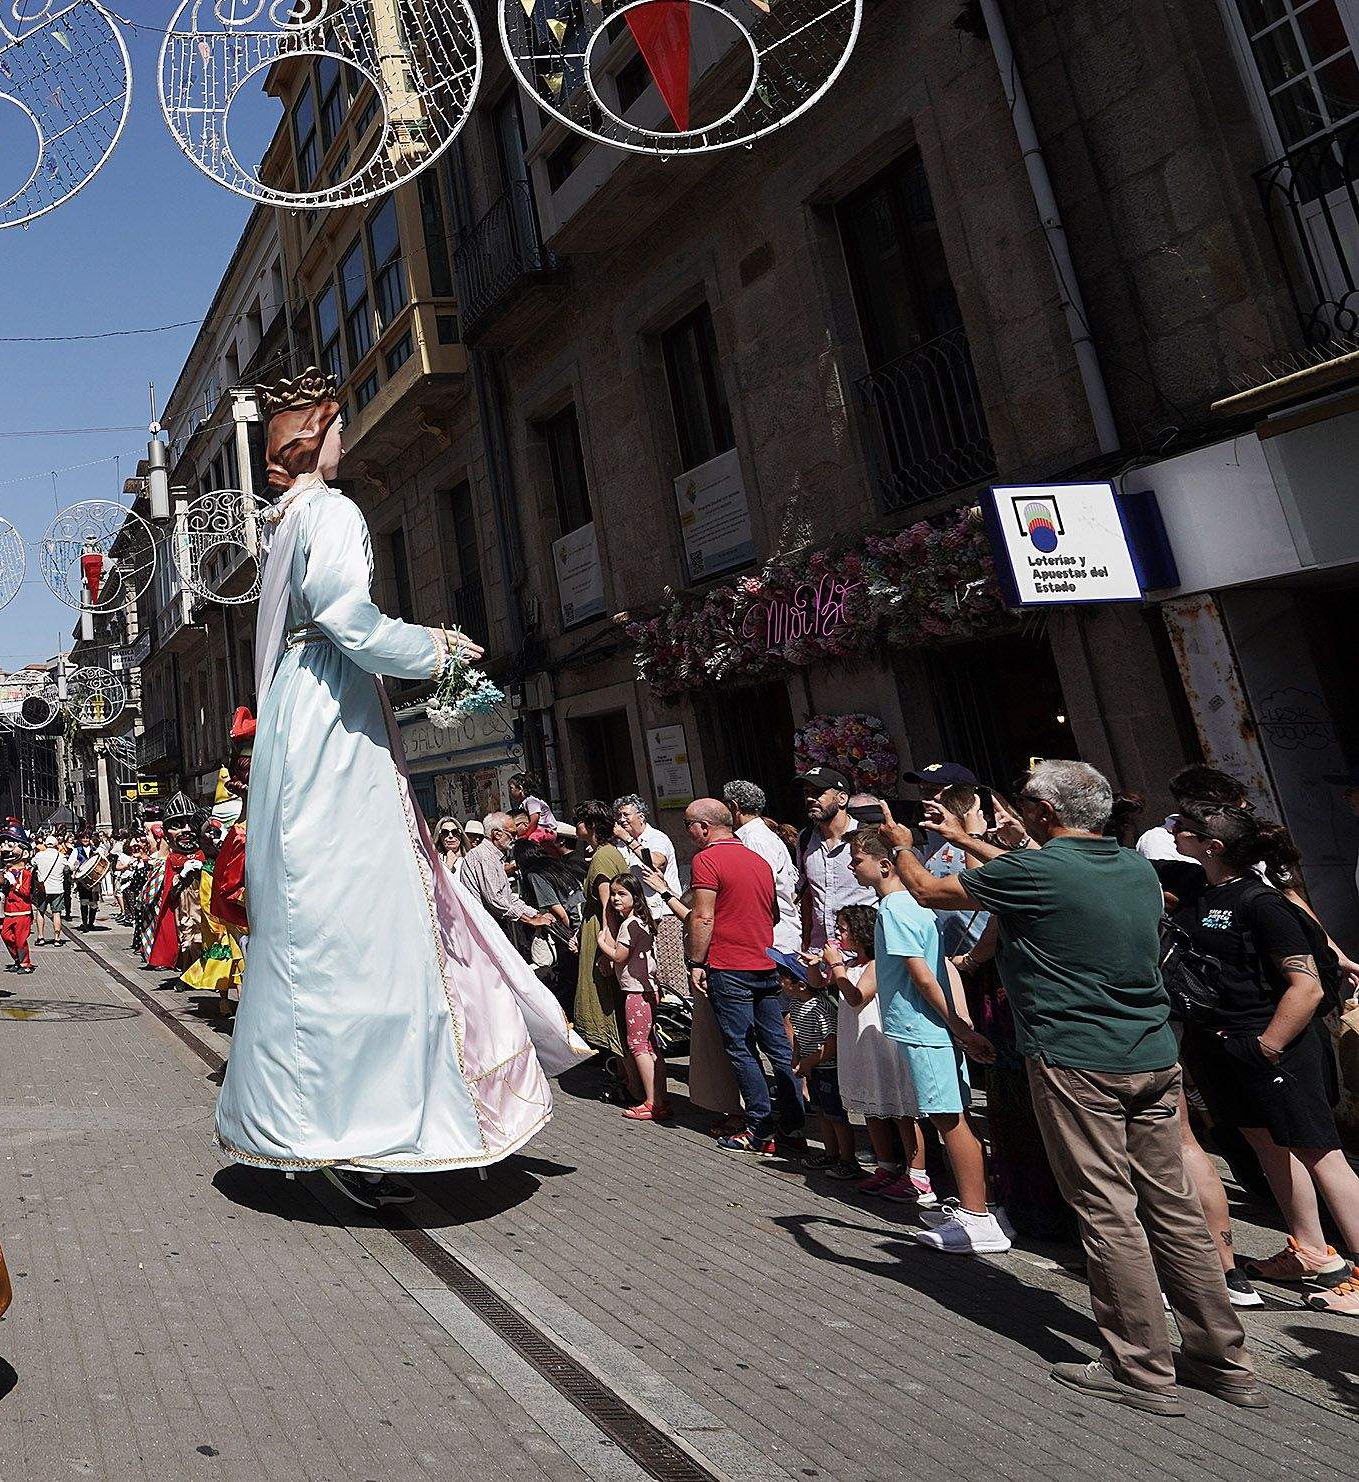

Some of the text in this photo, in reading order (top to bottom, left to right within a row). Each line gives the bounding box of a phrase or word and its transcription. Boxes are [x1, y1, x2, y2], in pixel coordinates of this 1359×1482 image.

[1028, 555, 1085, 567] Loterías y
[1033, 566, 1108, 581] Apuestas del
[1035, 581, 1076, 593] Estado
